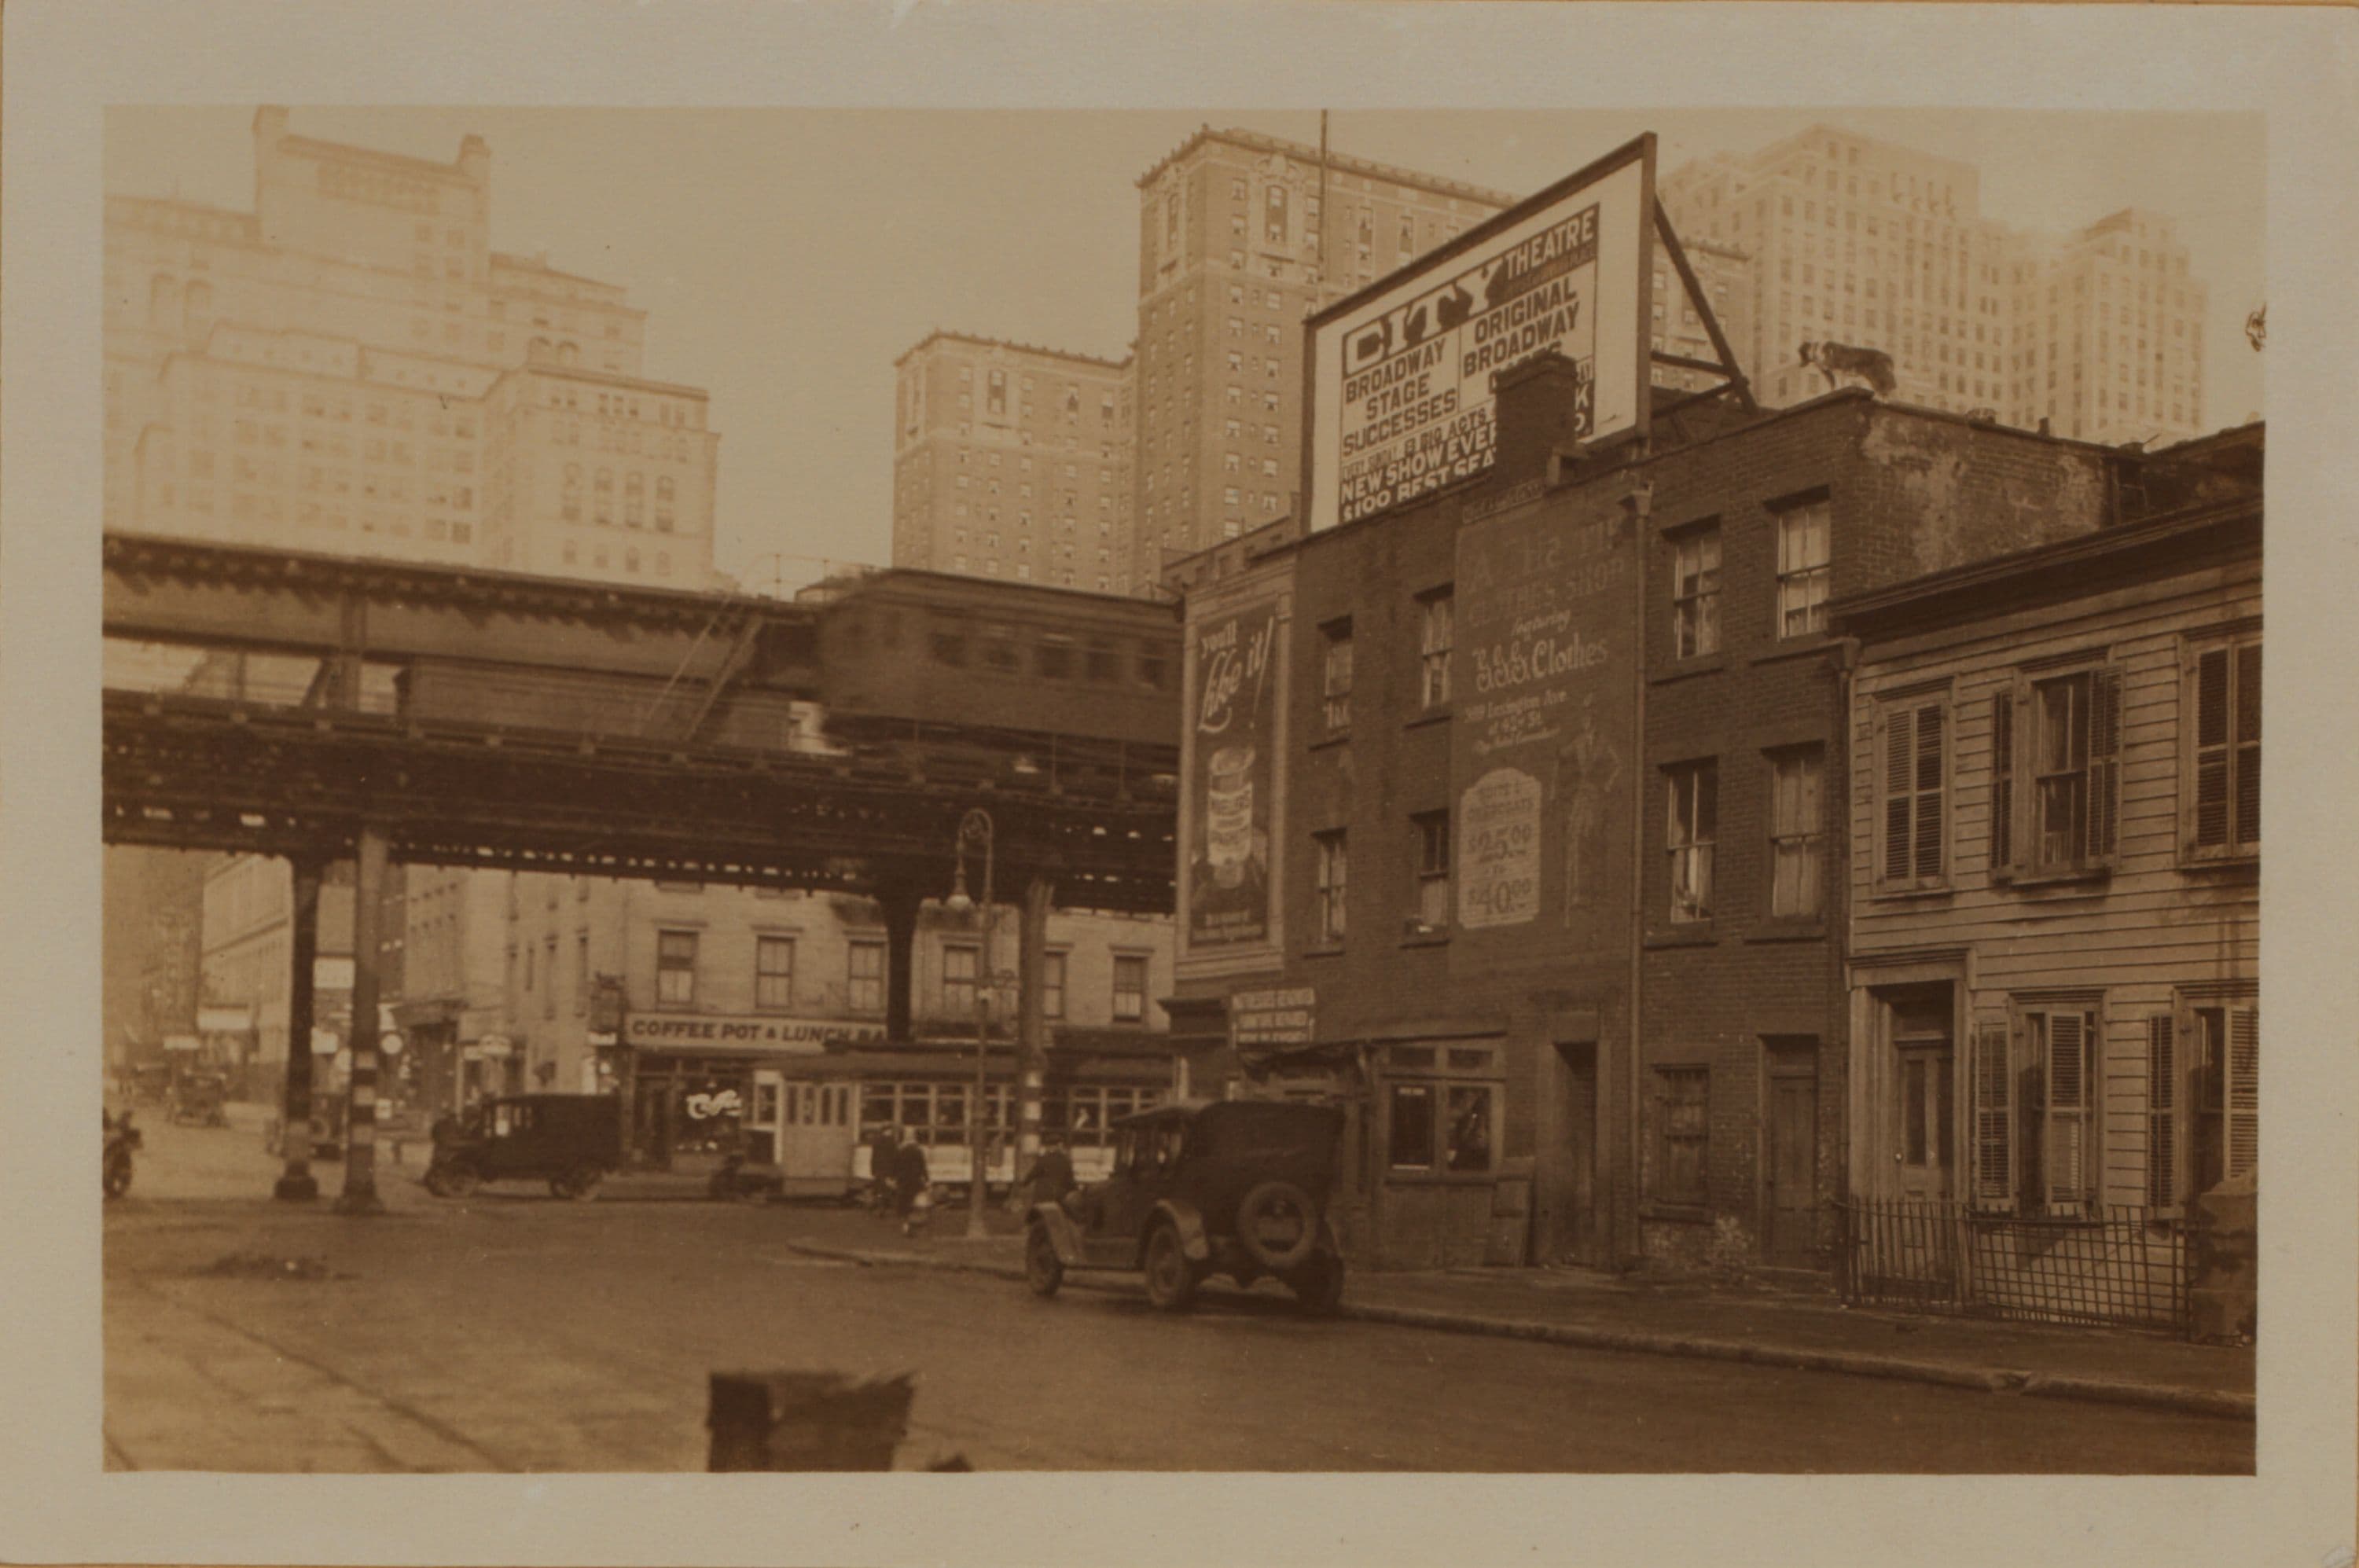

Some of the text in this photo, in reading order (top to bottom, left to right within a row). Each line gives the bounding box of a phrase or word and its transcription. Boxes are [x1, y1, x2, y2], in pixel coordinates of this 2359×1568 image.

[1346, 257, 1505, 376] CITY
[1505, 208, 1596, 280] THEATRE
[1475, 276, 1577, 345] ORIGINAL
[1345, 336, 1446, 405] BROADWAY
[1464, 300, 1580, 380] BROADWAY
[1343, 387, 1457, 457] SUCCESSES
[1365, 371, 1431, 420] STAGE
[1450, 407, 1486, 439] ACTS
[1341, 469, 1383, 505] NEW
[1386, 443, 1444, 487] SHOW
[1454, 444, 1497, 477] SEA
[1531, 631, 1609, 679] Clothes
[633, 1020, 716, 1039] COFFEE
[720, 1023, 762, 1040] POT
[782, 1025, 850, 1043] LUNCH
